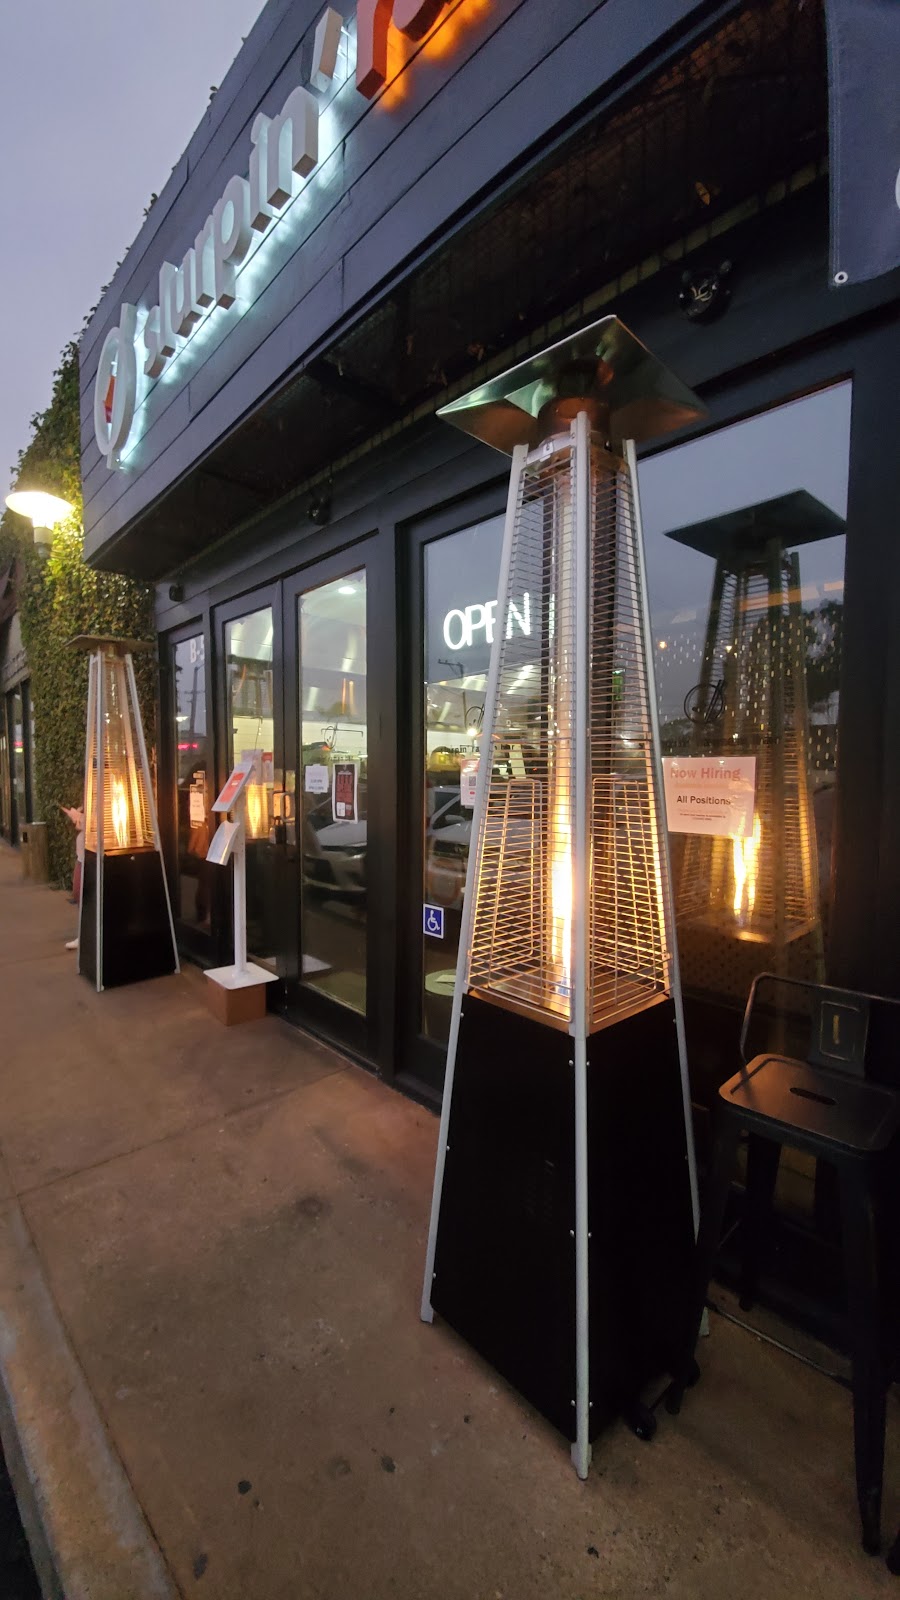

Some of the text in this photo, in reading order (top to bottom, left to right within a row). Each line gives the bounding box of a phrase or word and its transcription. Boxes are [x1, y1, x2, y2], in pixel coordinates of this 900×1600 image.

[670, 767, 741, 781] Now Hiring
[676, 795, 731, 806] All Positions
